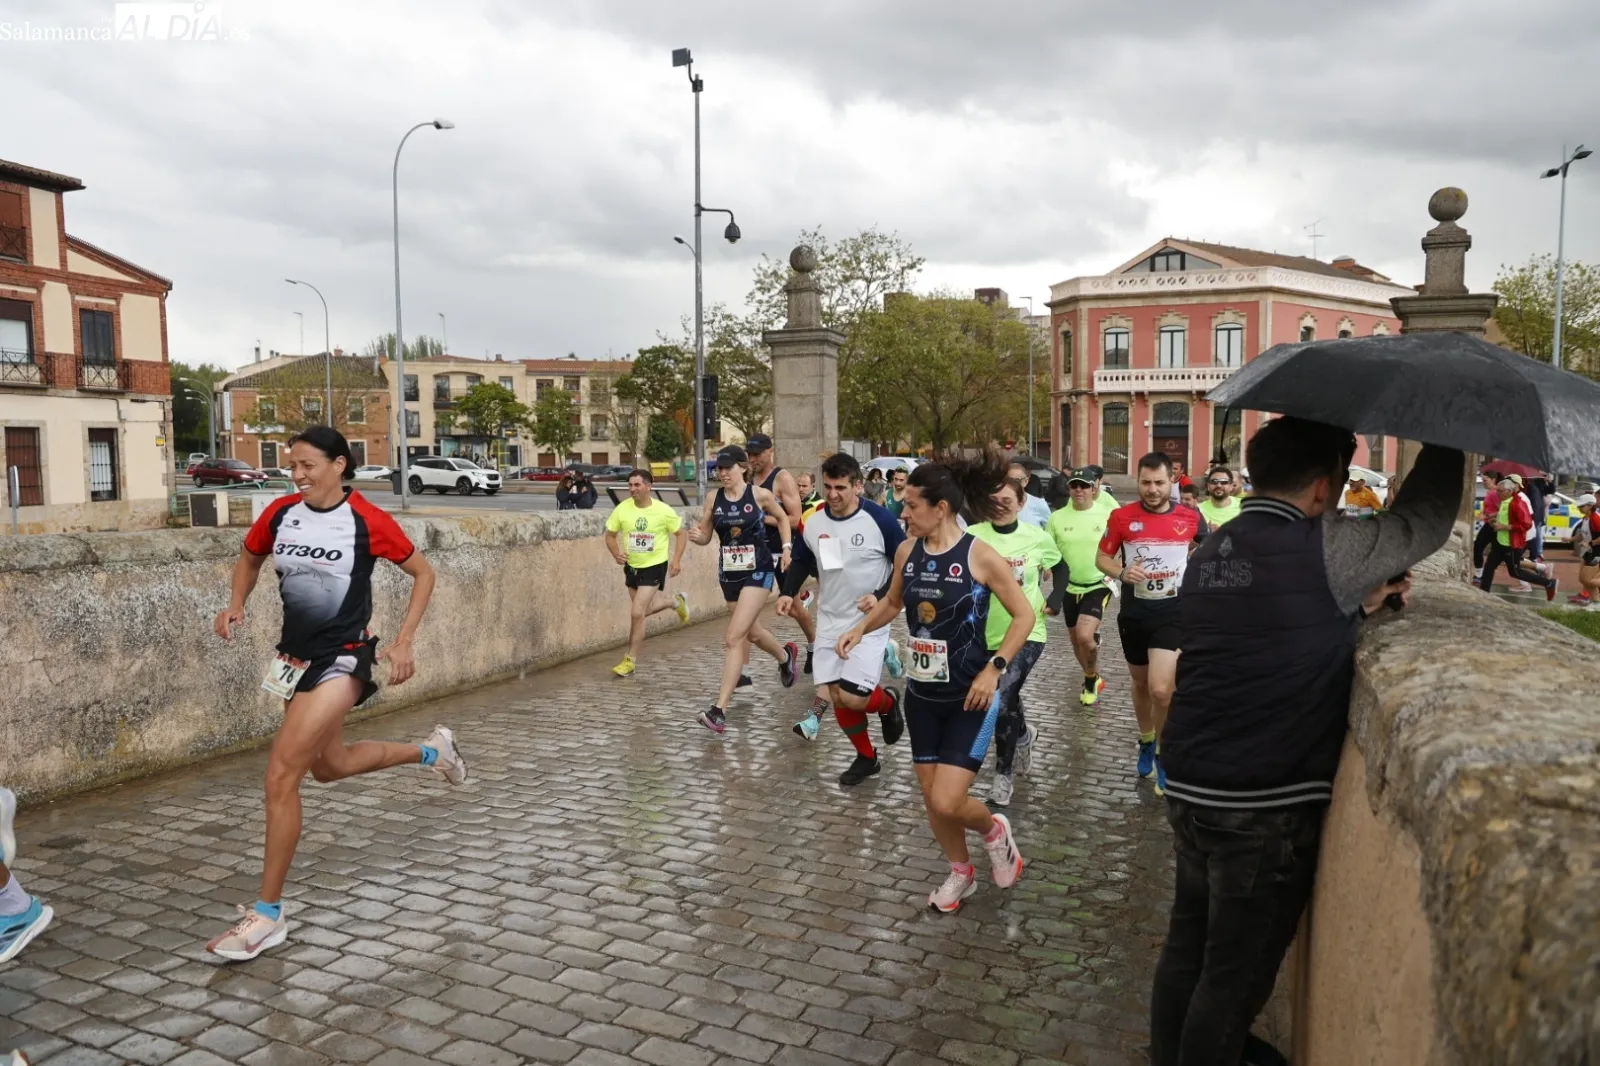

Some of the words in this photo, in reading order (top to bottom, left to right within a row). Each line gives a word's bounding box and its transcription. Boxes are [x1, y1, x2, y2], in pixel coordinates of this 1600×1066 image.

[635, 538, 647, 546] 56
[275, 543, 343, 561] 37300
[731, 553, 744, 563] 91
[1199, 560, 1252, 587] PLNS
[1146, 580, 1164, 591] 65
[912, 652, 930, 669] 90
[280, 664, 297, 684] 76
